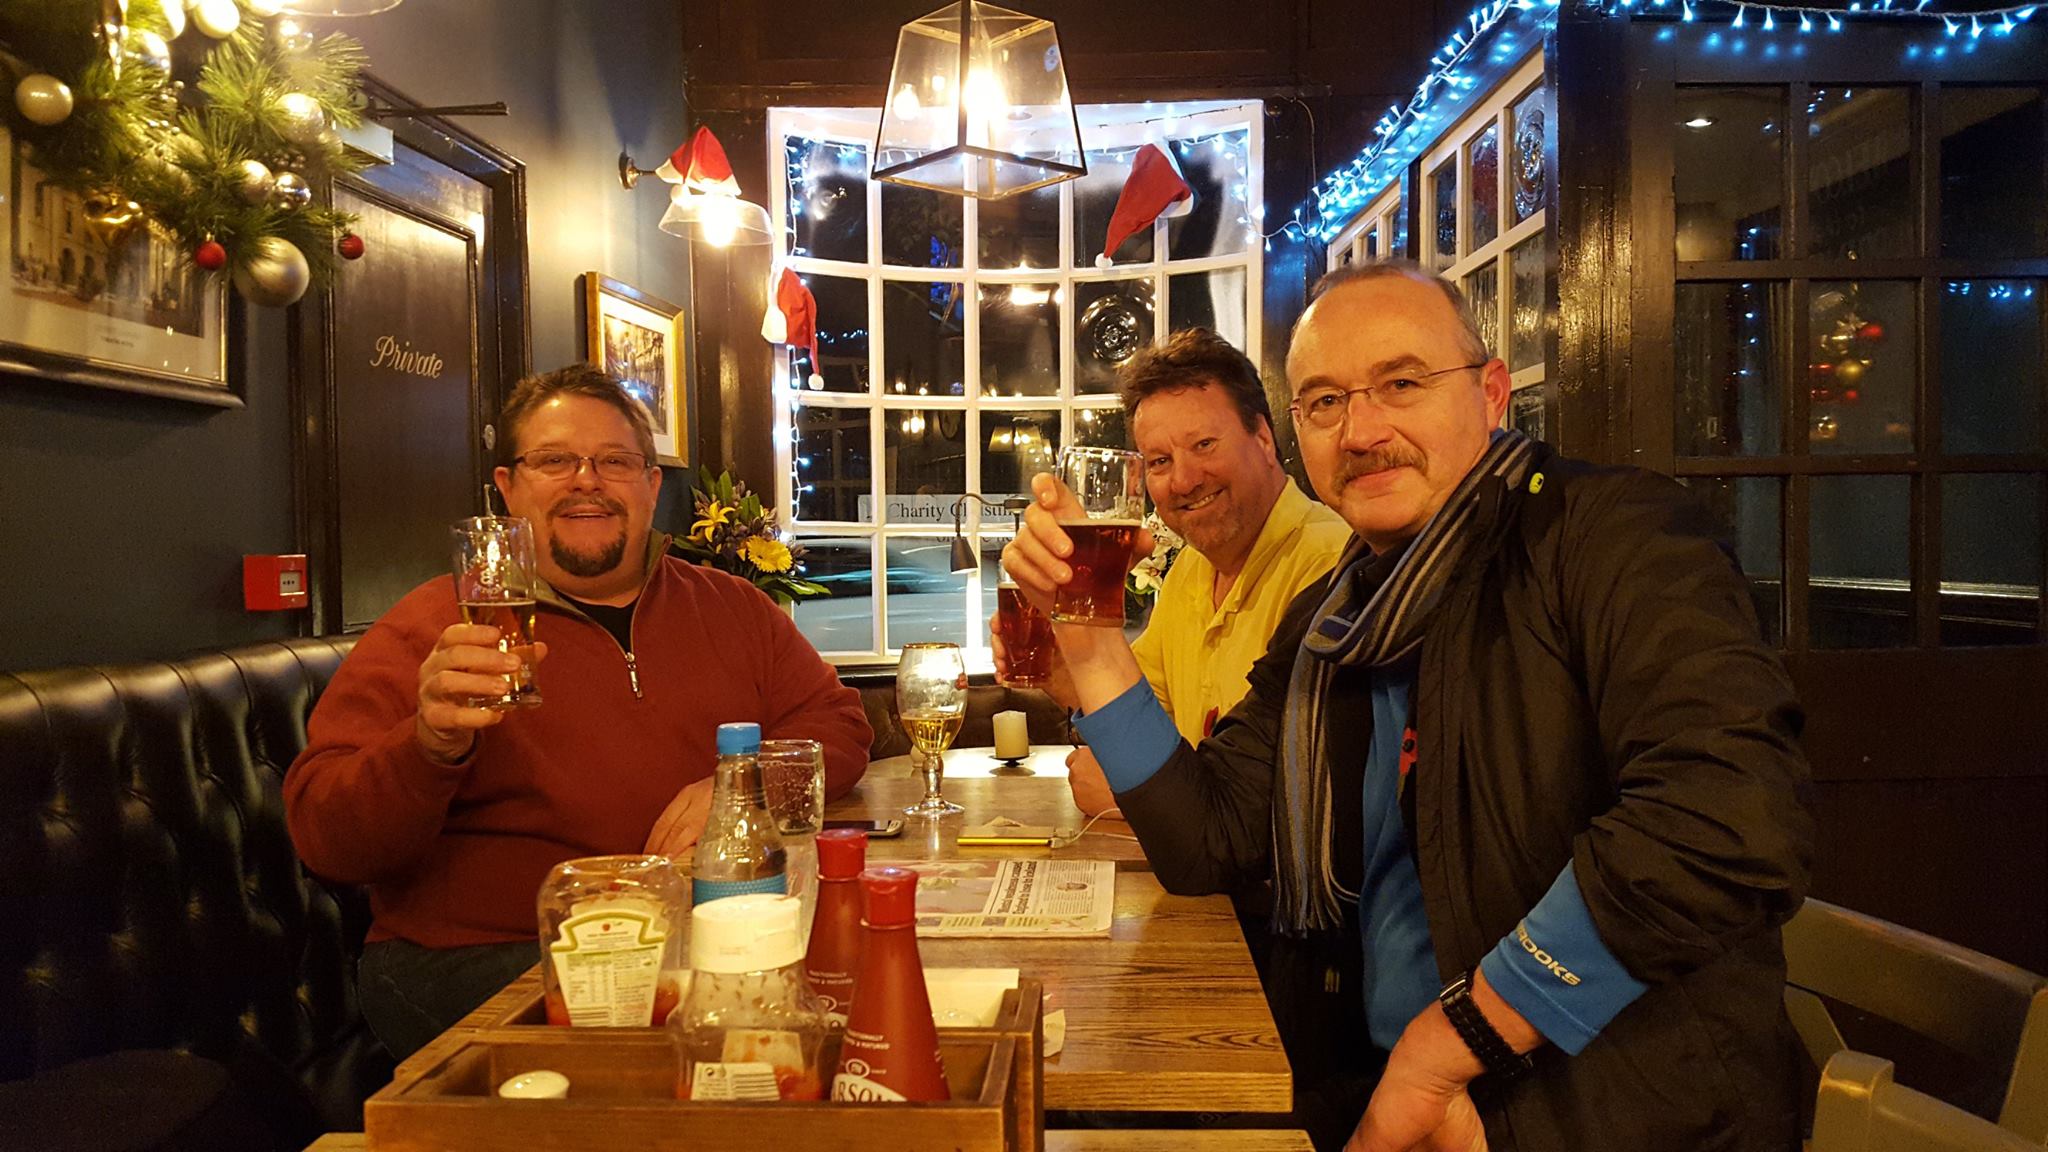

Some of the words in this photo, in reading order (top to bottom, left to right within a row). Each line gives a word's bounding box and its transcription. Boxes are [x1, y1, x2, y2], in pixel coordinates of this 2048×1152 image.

[370, 335, 443, 379] Private
[889, 502, 945, 522] Charity
[1516, 920, 1581, 985] ROOKS
